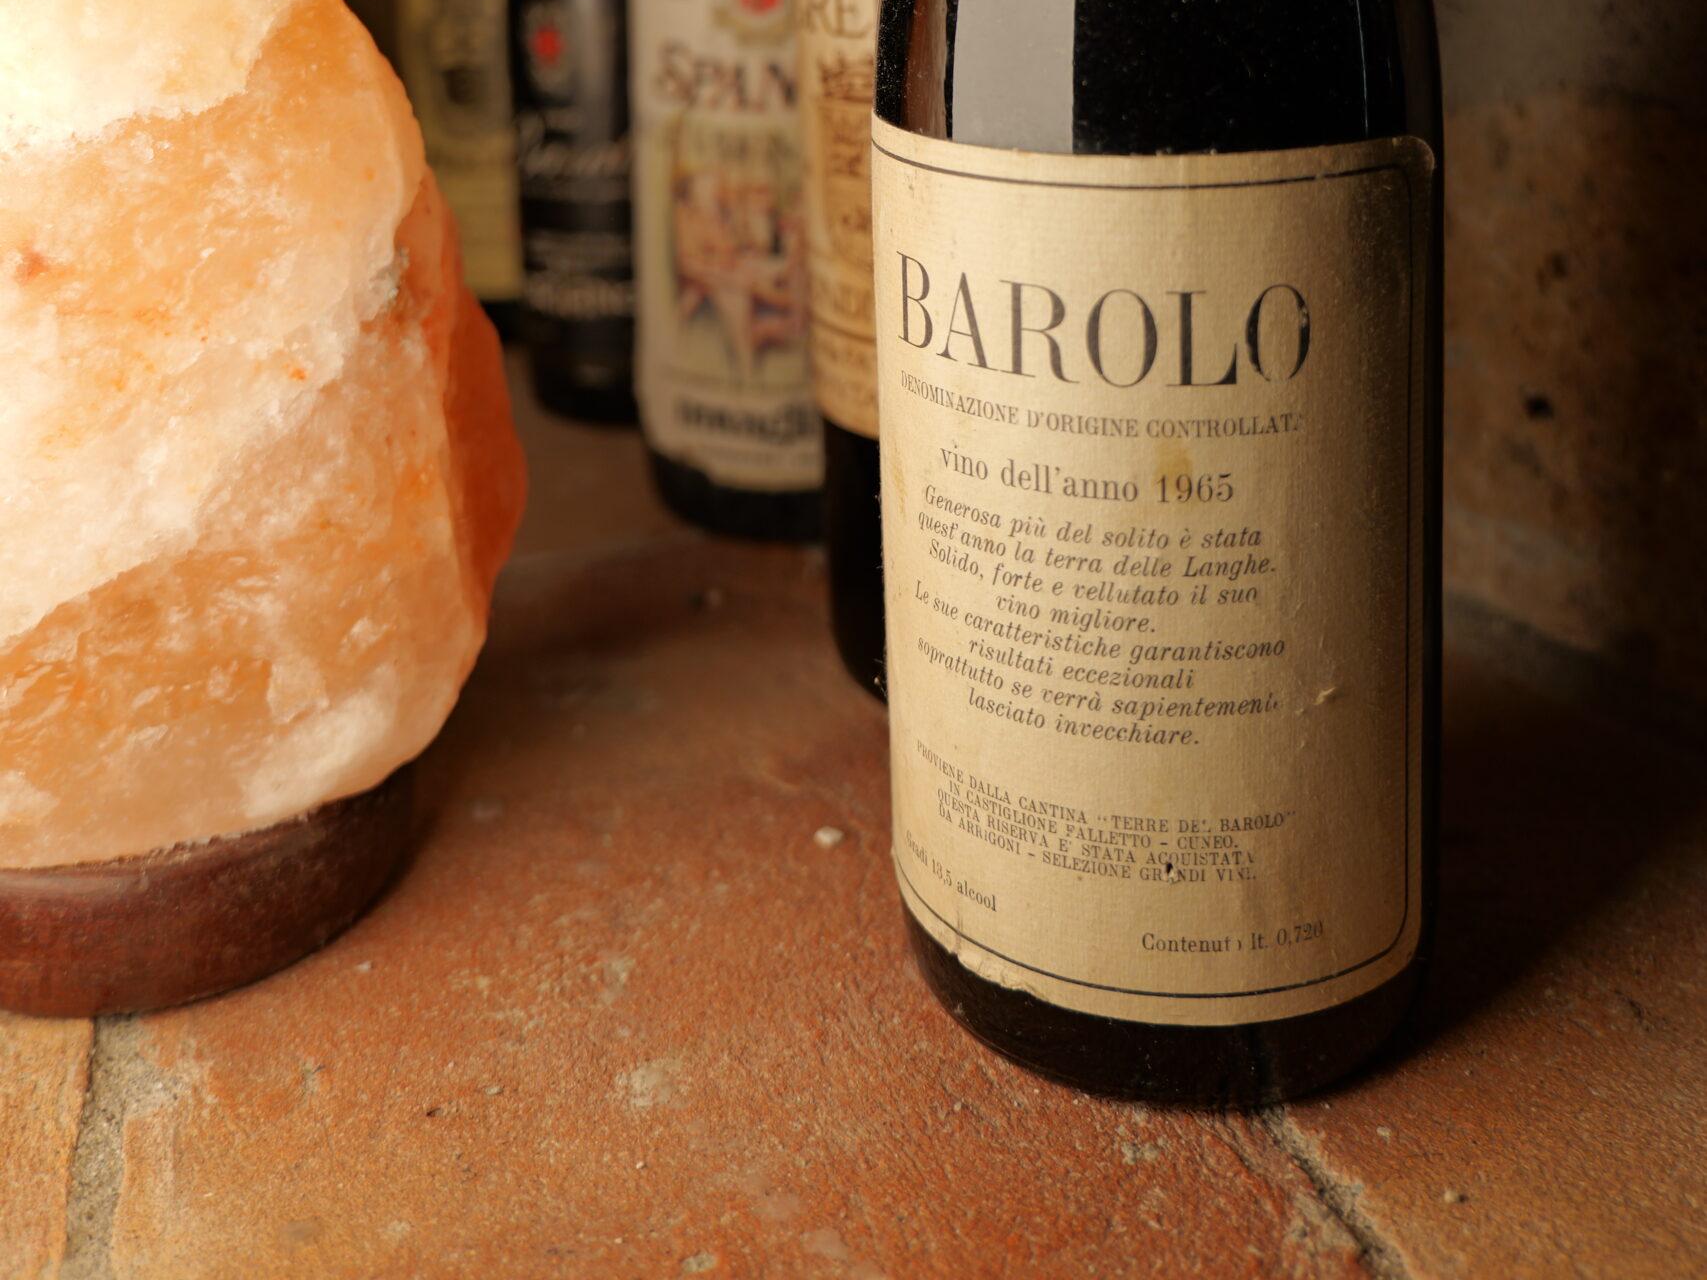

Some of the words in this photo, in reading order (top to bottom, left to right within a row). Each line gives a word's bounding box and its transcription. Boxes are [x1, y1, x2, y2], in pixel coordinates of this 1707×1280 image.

[896, 250, 1311, 388] BAROLO
[901, 370, 1019, 426] DENOMINAZIONE
[1027, 409, 1139, 438] D'ORIGINE
[1146, 412, 1303, 439] CONTROLLAT
[940, 443, 988, 481] vino
[1000, 458, 1138, 502] dell'anno
[1156, 472, 1234, 504] 1965
[925, 484, 1002, 529] Generosa
[1008, 515, 1047, 538] più
[1056, 521, 1093, 544] del
[1101, 526, 1169, 550] solito
[1179, 528, 1192, 549] è
[1200, 526, 1262, 549] stata
[929, 538, 984, 581] Solido,
[992, 563, 1044, 593] forte
[1051, 579, 1064, 596] e
[1072, 581, 1180, 606] vellutato
[1191, 584, 1208, 605] il
[1217, 586, 1258, 605] suo
[1014, 541, 1035, 564] la
[1045, 548, 1103, 574] terra
[1113, 555, 1172, 577] delle
[1181, 553, 1277, 581] Langhe.
[915, 579, 929, 604] Le
[933, 597, 959, 620] sue
[964, 611, 1121, 658] caratteristiche
[1129, 639, 1286, 665] garantiscono
[995, 594, 1041, 620] vino
[1049, 607, 1156, 633] migliore.
[917, 636, 1004, 690] soprattutto
[1011, 681, 1033, 699] se
[1041, 688, 1102, 712] verrà
[968, 638, 1054, 677] risultati
[1062, 665, 1195, 689] eccezionali
[968, 686, 1046, 729] lasciato
[1055, 714, 1200, 745] invecchiare.
[917, 739, 964, 784] PROVIENE
[969, 774, 1012, 805] DALLA
[1018, 796, 1088, 825] CANTINA
[949, 780, 961, 797] IN
[966, 788, 1058, 834] CASTIGLIONE
[1066, 823, 1151, 849] FALLETTO
[1177, 834, 1239, 850] CUNEO.
[937, 788, 980, 822] QUESTA
[987, 815, 1049, 848] RISERVA
[1059, 839, 1072, 853] E'
[1081, 844, 1136, 864] STATA
[938, 803, 952, 824] DA
[958, 816, 1021, 855] ARRIGONI
[1042, 851, 1131, 879] SELEZIONE
[1139, 868, 1206, 882] GRNDI
[906, 829, 928, 867] Gradi
[932, 858, 952, 887] 13,5
[957, 880, 997, 912] alcool
[1251, 932, 1269, 951] lt.
[1276, 919, 1324, 947] 0,720
